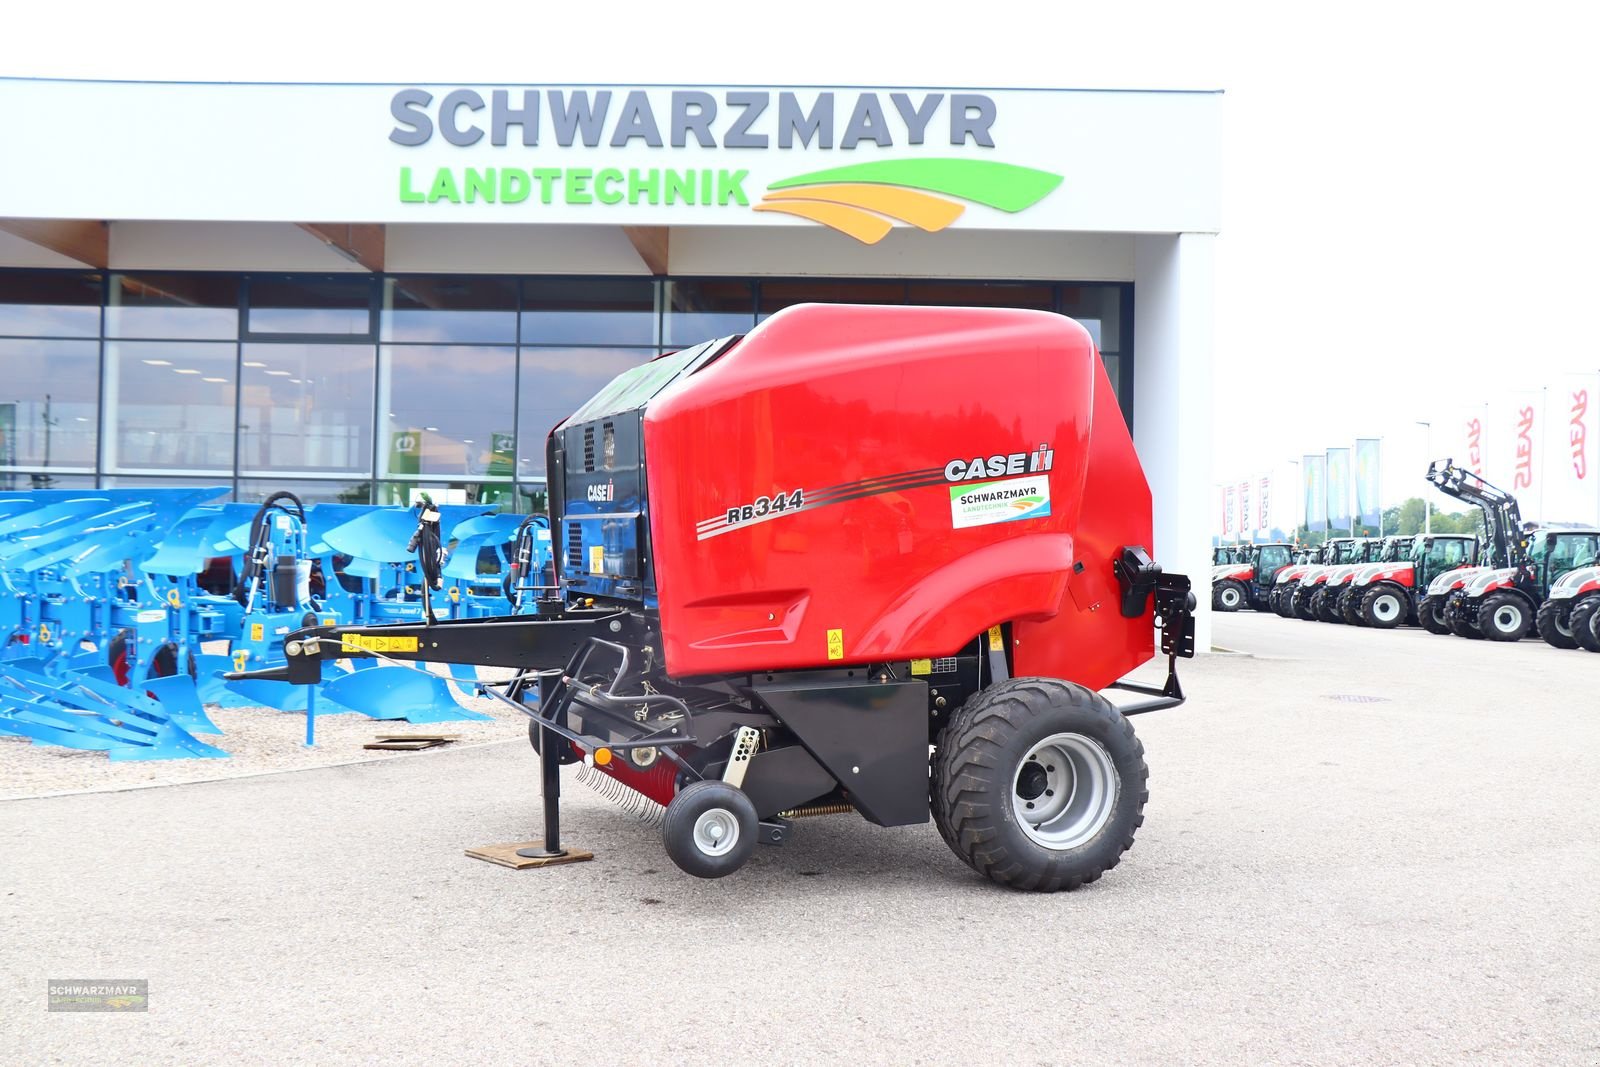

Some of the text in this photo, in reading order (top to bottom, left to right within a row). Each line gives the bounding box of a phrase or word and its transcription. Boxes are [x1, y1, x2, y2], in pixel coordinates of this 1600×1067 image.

[389, 88, 998, 150] SCHWARZMAYR
[400, 166, 750, 206] LANDTECHNIK
[944, 453, 1027, 482] CASE
[587, 484, 607, 502] CASE
[727, 488, 805, 524] RB344
[960, 487, 1037, 505] SCHWARZMAYR
[963, 502, 1009, 513] LANDTECHNIK
